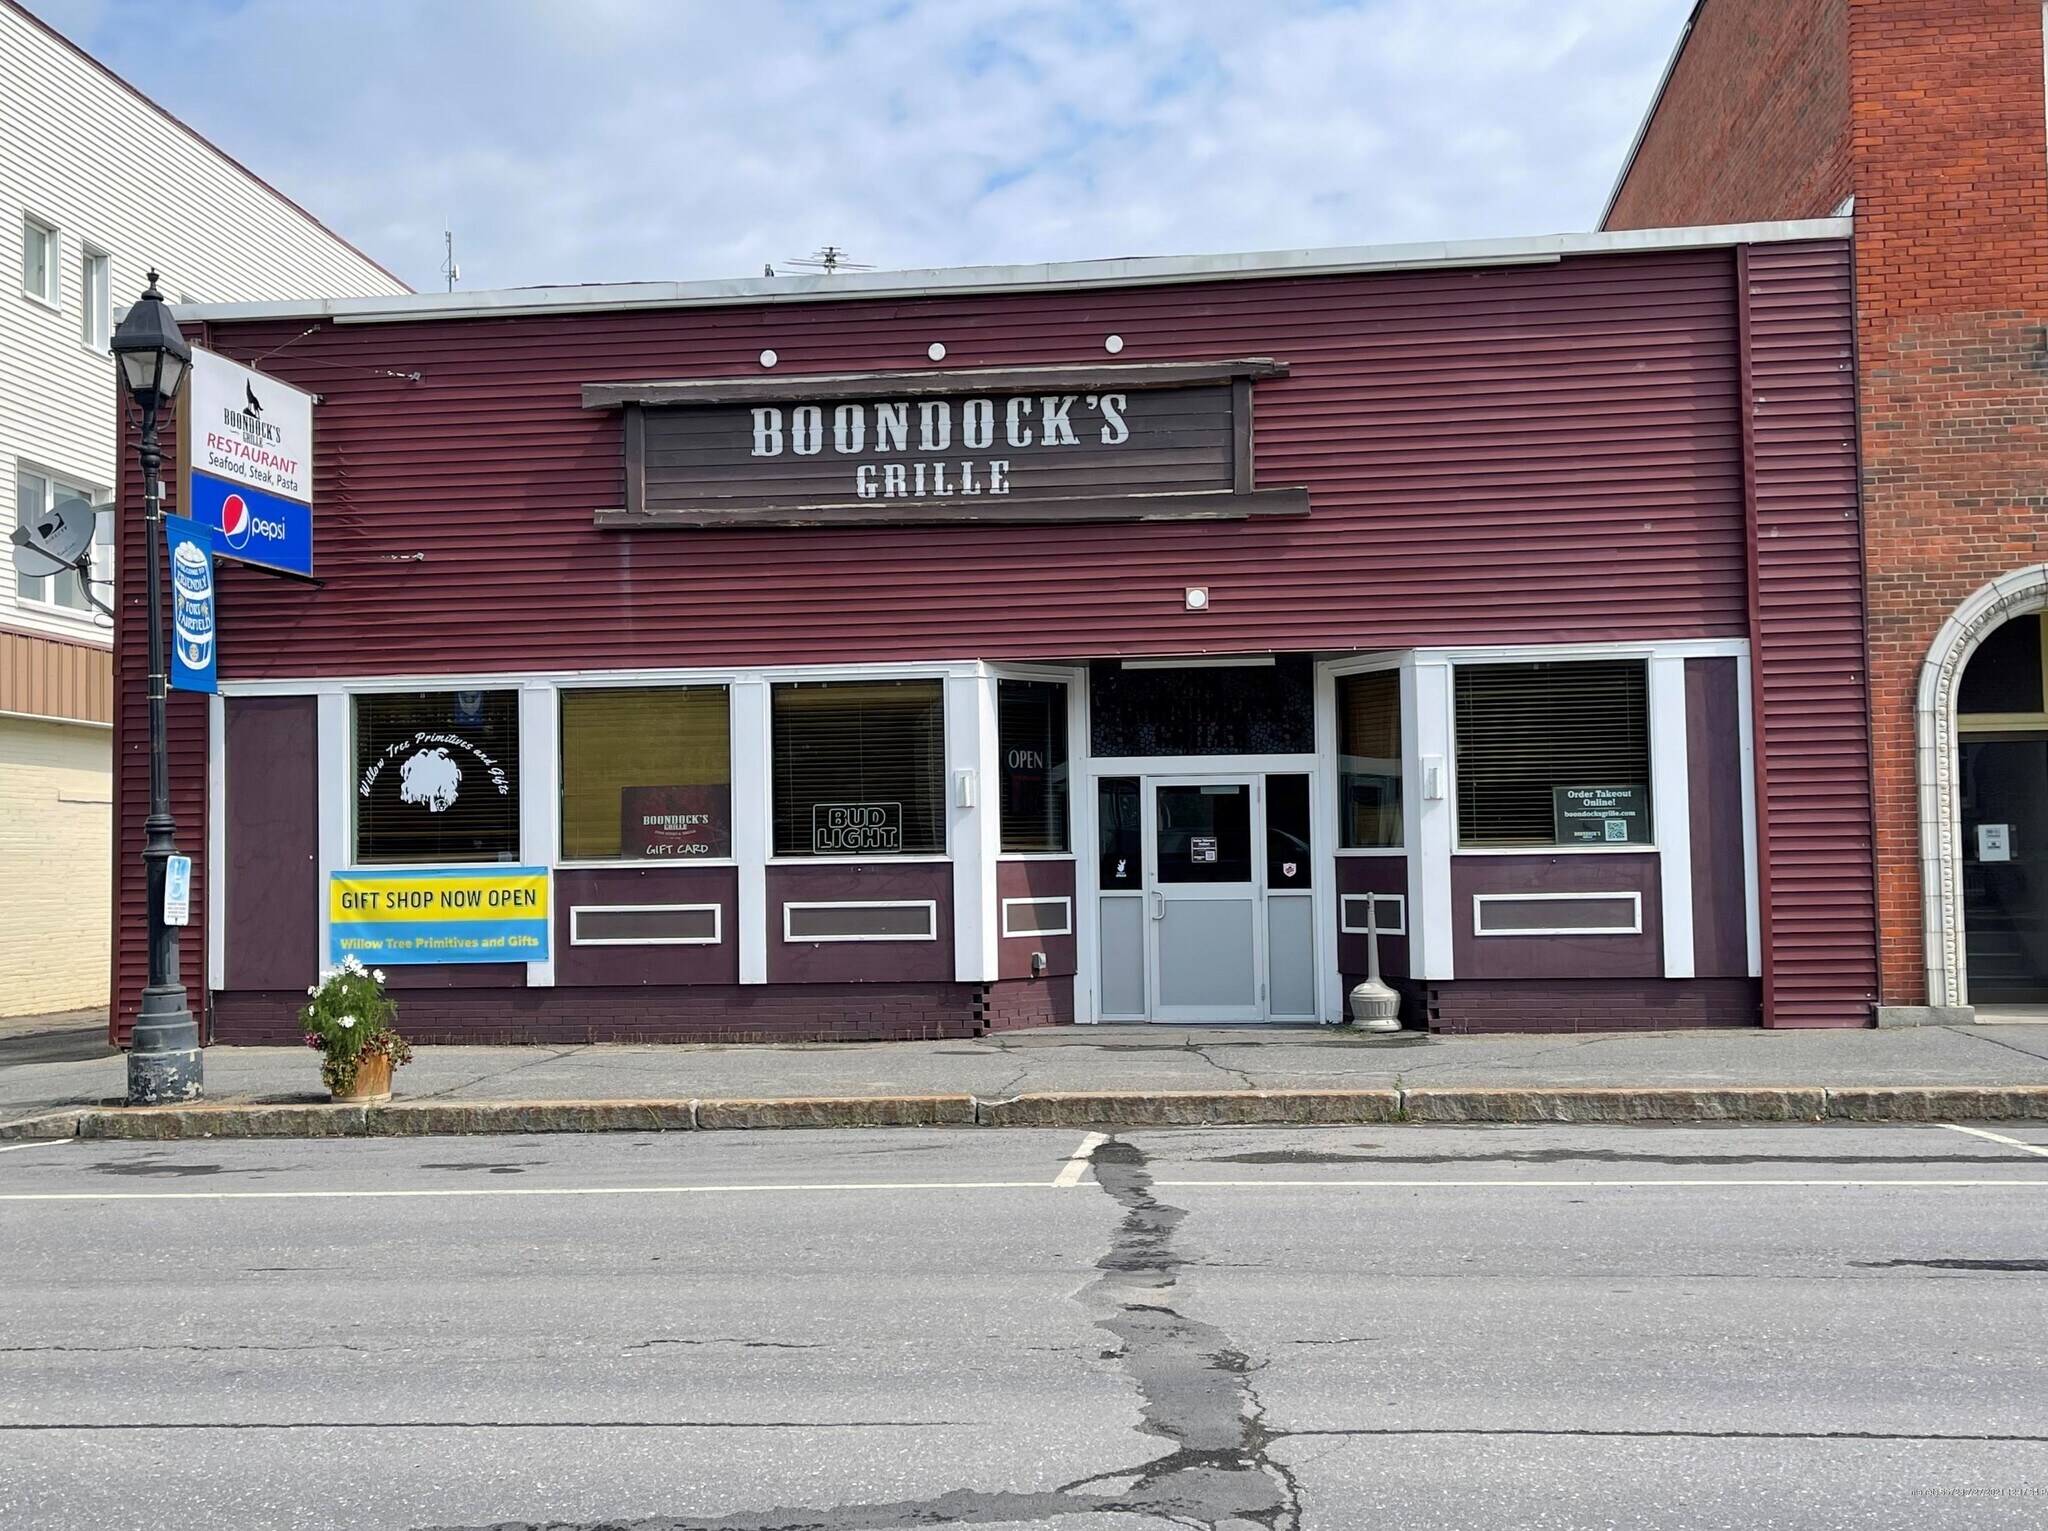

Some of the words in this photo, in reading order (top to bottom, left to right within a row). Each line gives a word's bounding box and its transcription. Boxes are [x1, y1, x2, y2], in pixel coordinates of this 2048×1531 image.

[224, 408, 281, 443] BOONDOCK'S
[750, 393, 1130, 457] BOONDOCK'S
[242, 431, 263, 448] GRILLE
[207, 432, 298, 474] RESTAURANT
[209, 452, 247, 477] Seafood,
[249, 465, 274, 486] Steak,
[276, 474, 298, 492] Pasta
[856, 460, 1010, 499] GRILLE
[251, 516, 286, 540] pepsi
[177, 570, 207, 591] FRIENDLY
[186, 601, 201, 615] FORT
[177, 610, 211, 631] FAIRFIELD
[359, 758, 385, 797] Willow
[385, 740, 410, 758] Tree
[414, 732, 474, 750] Primitives
[473, 749, 498, 766] and
[487, 767, 509, 795] Gifts
[1008, 749, 1043, 769] OPEN
[1567, 790, 1594, 798] Order
[1595, 789, 1632, 798] Takeout
[1583, 799, 1616, 807] Online!
[642, 814, 709, 825] BOONDOCK'S
[828, 807, 886, 829] BUD
[1564, 810, 1636, 818] boondocksgrille.com
[646, 844, 673, 855] GIFT
[677, 844, 709, 854] CARD
[341, 892, 379, 909] GIFT
[386, 891, 433, 908] SHOP
[441, 890, 481, 907] NOW
[488, 888, 536, 907] OPEN
[340, 938, 383, 950] Willow
[385, 937, 412, 949] Tree
[415, 936, 479, 949] Primitives
[481, 936, 505, 947] and
[508, 935, 539, 947] Gifts
